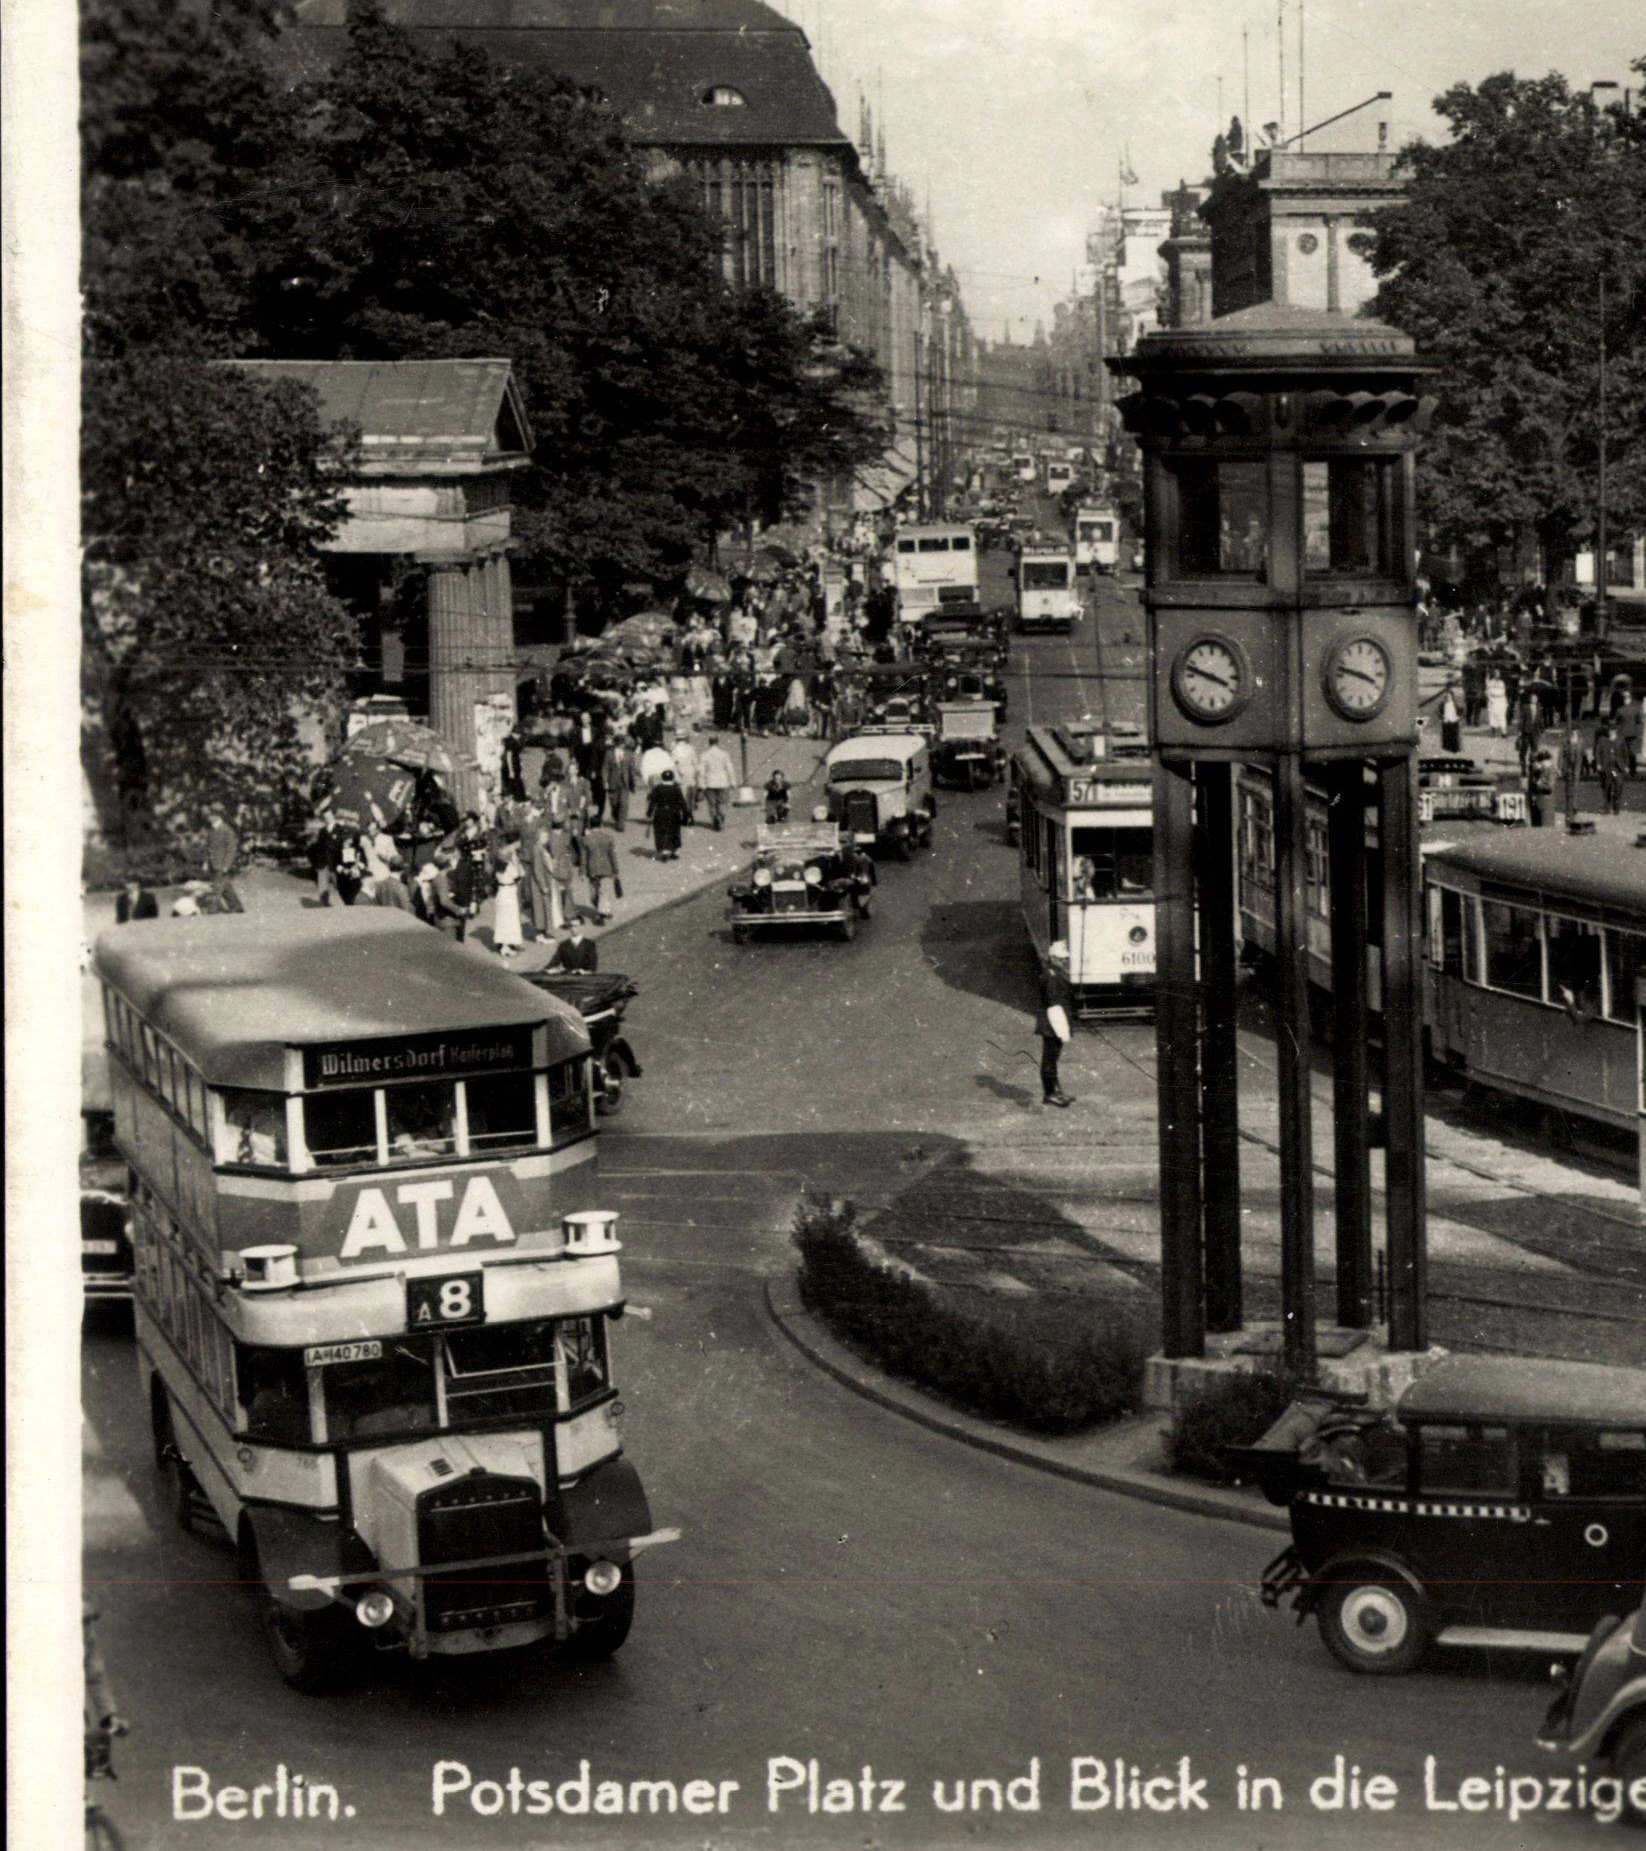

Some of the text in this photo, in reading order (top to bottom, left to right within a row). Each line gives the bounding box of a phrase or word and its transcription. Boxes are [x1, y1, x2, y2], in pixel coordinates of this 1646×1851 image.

[1073, 780, 1092, 801] 57
[321, 1044, 446, 1075] Wilmersdorf
[340, 1176, 515, 1257] ATA
[418, 1280, 471, 1321] A 8
